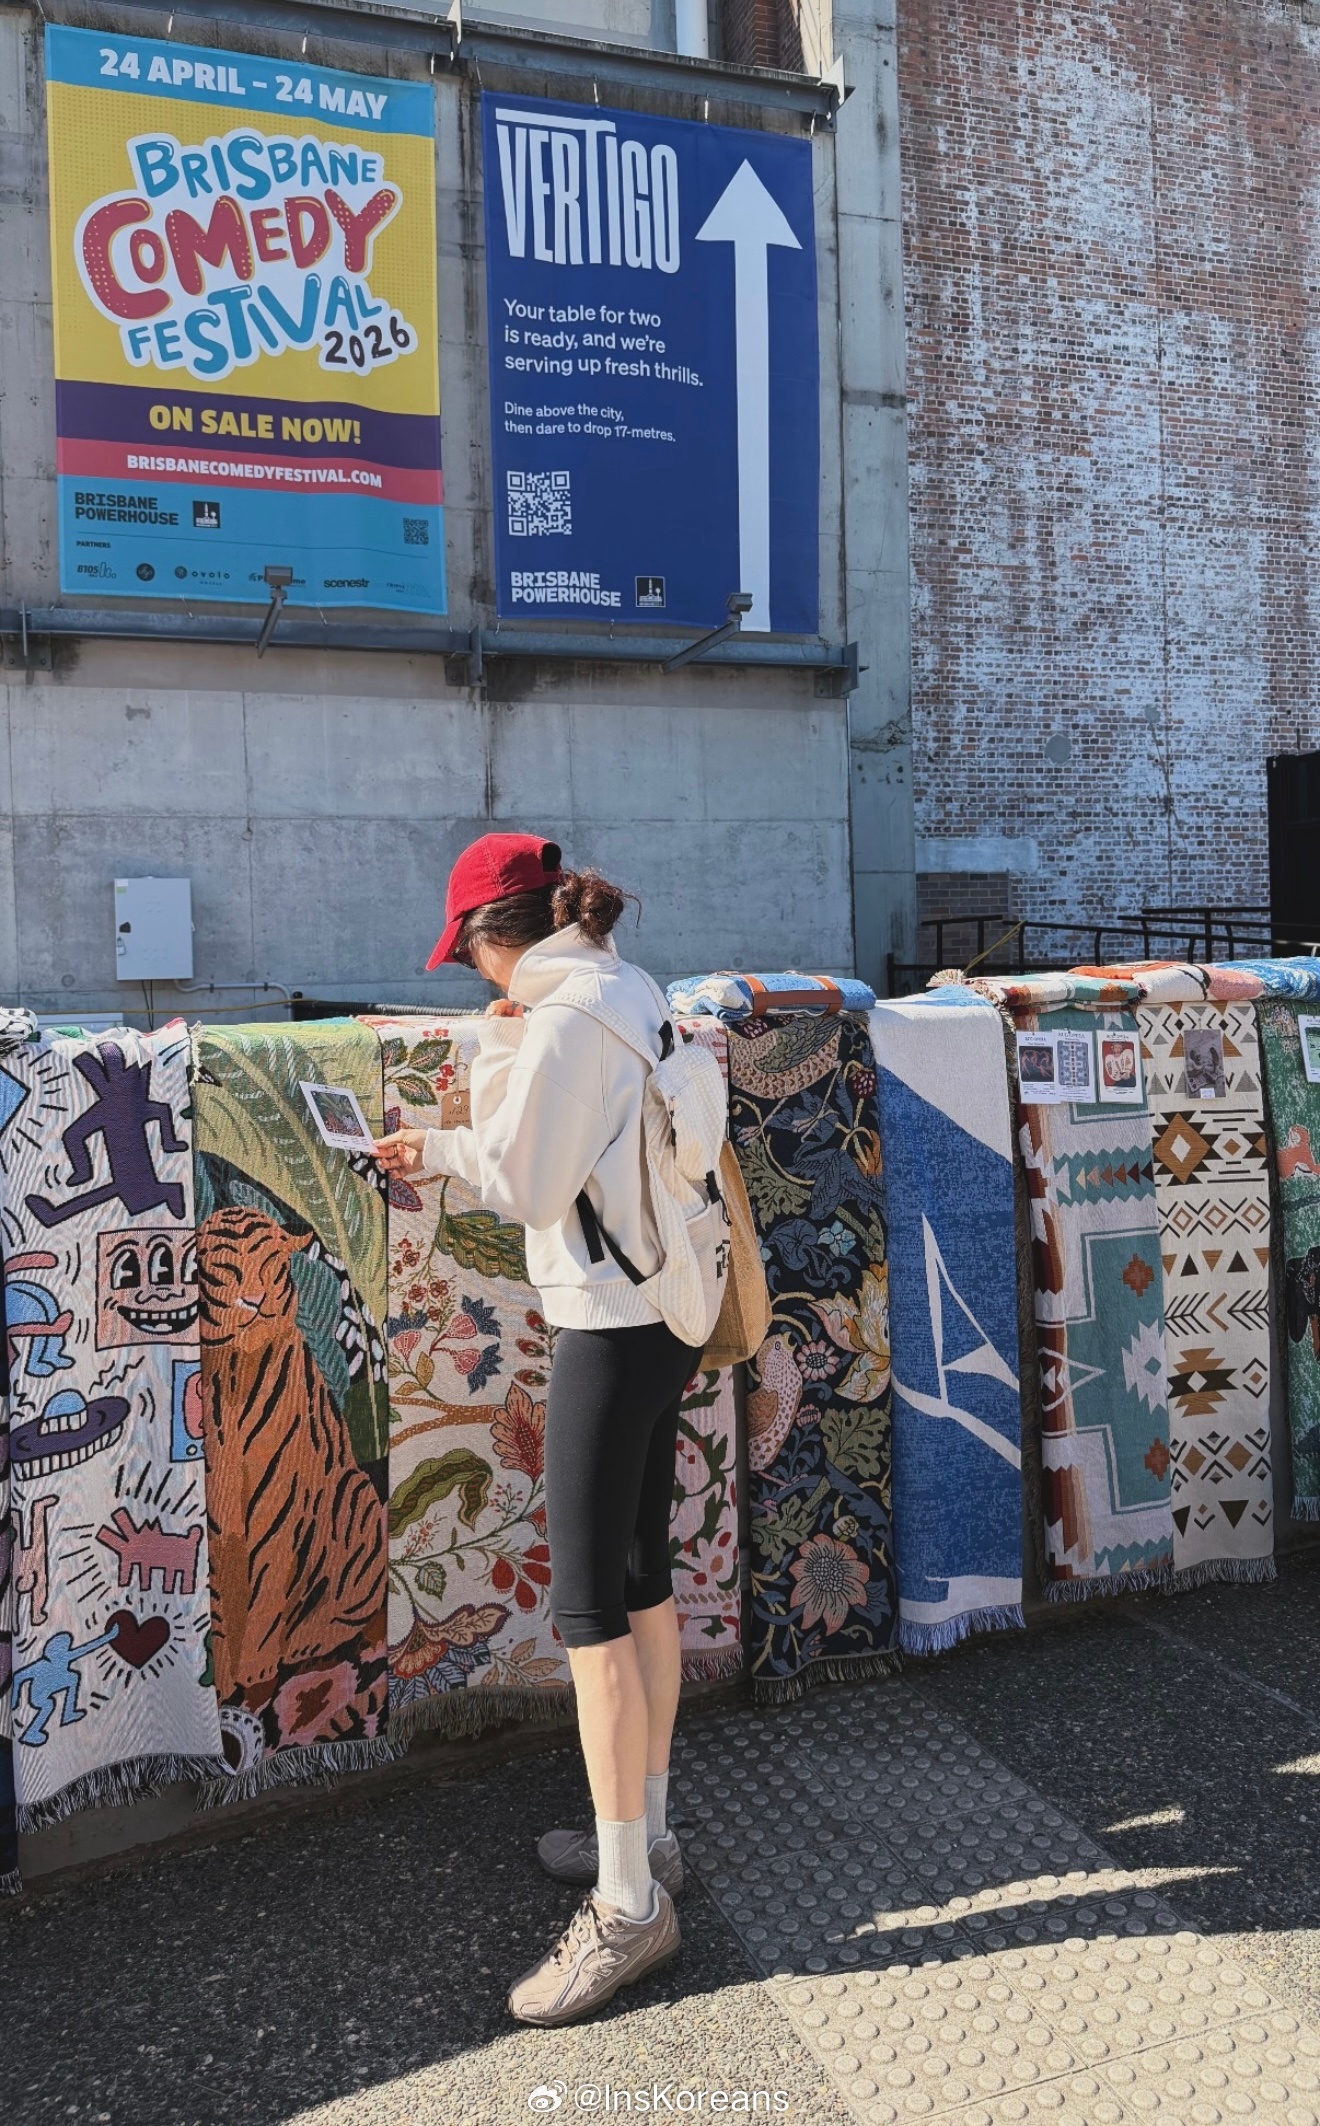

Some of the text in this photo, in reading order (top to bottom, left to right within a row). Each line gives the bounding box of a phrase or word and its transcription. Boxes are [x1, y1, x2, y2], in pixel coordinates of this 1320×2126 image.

[100, 48, 141, 79] 24
[147, 56, 245, 95] APRIL
[275, 75, 313, 105] 24
[319, 83, 388, 120] MAY
[135, 135, 377, 200] BRISBANE
[495, 107, 681, 274] VERTIGO
[83, 188, 397, 320] COMEDY
[128, 273, 382, 374] FESTIVAL
[504, 298, 661, 327] Your table for two
[324, 316, 410, 368] 2026
[505, 325, 666, 353] is ready, and we’re
[505, 355, 704, 387] serving up fresh thrills.
[149, 405, 361, 445] ON SALE NOW!
[504, 401, 624, 422] Dine above the city,
[504, 420, 676, 442] then dare to drop 17-metres.
[127, 454, 382, 488] BRISBANECOMEDYFESTIVAL.COM
[75, 491, 158, 510] BRISBANE
[75, 506, 179, 526] POWERHOUSE
[77, 541, 111, 549] PARTNERS
[324, 578, 370, 588] scenestr
[511, 571, 600, 590] BRISBANE
[511, 587, 621, 607] POWERHOUSE
